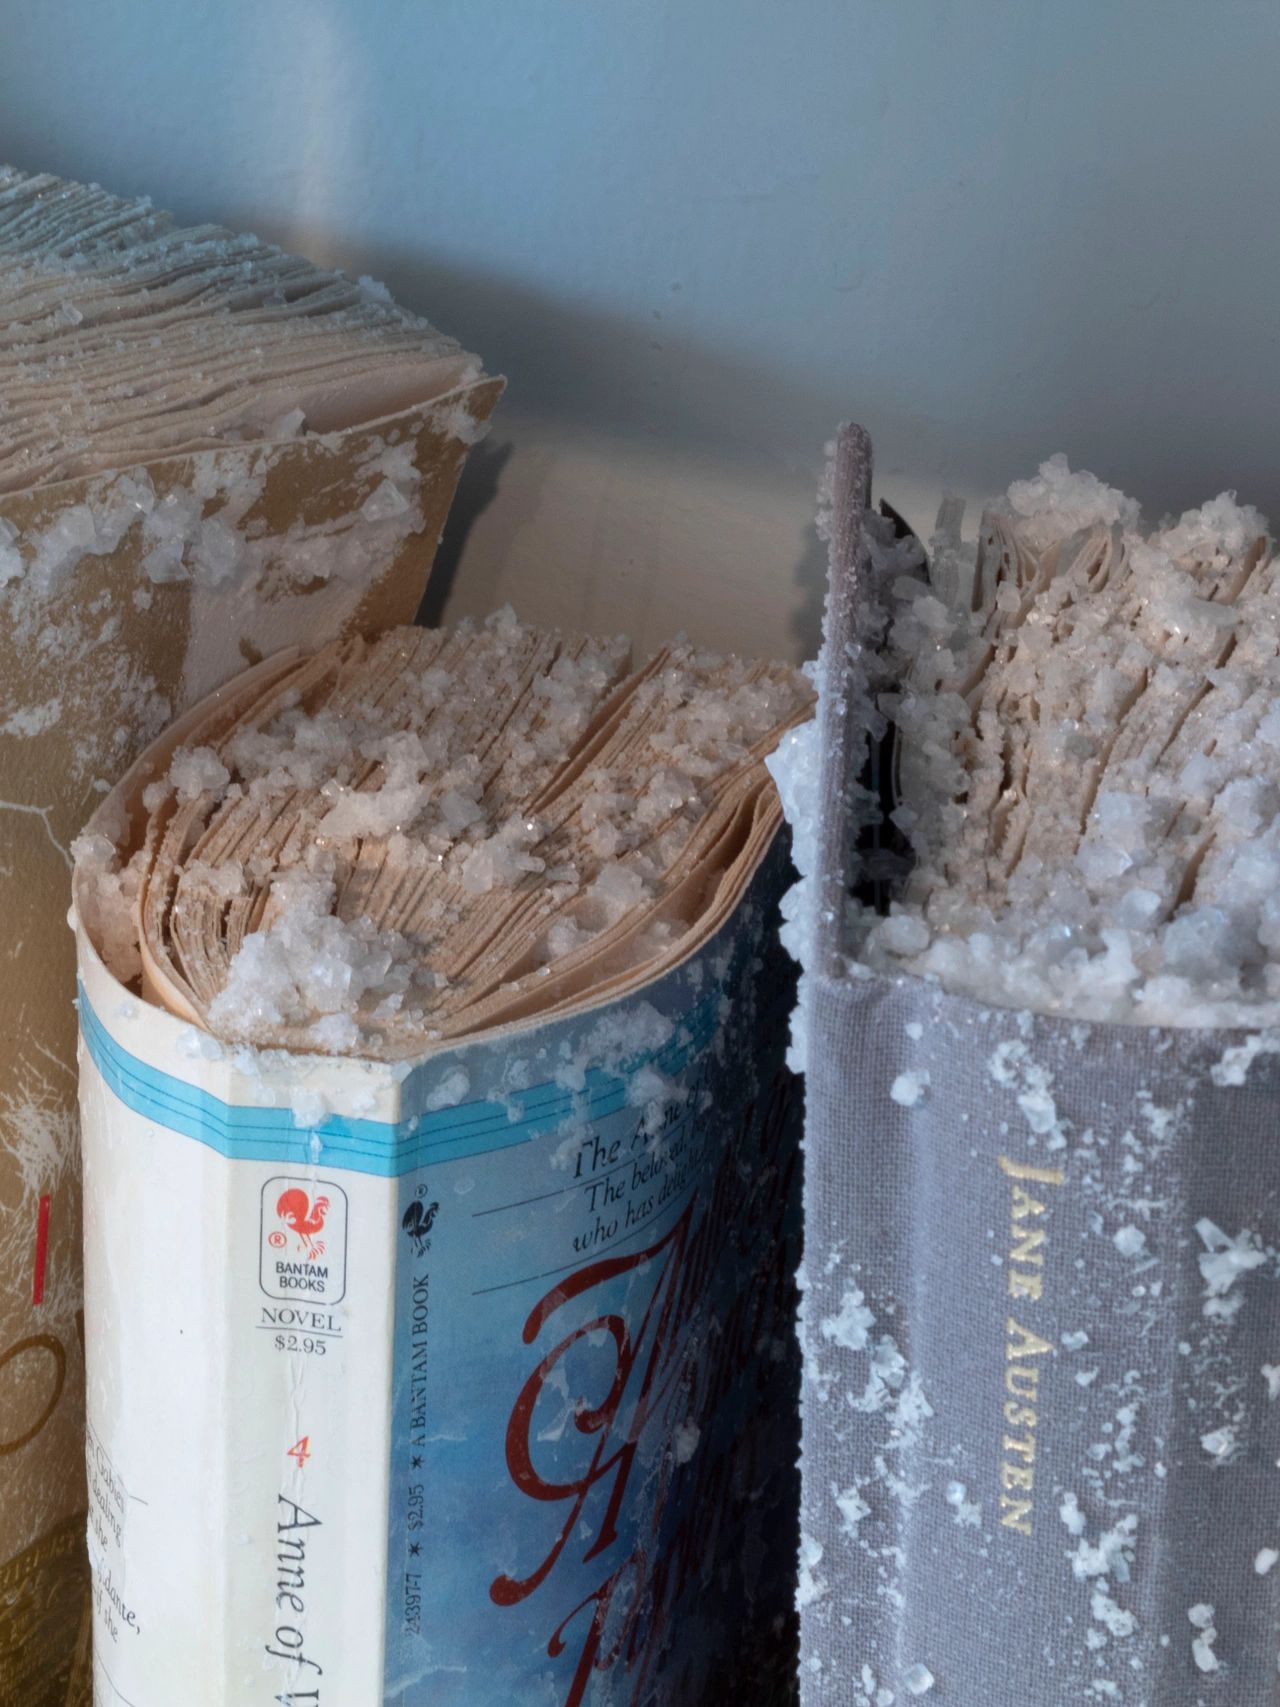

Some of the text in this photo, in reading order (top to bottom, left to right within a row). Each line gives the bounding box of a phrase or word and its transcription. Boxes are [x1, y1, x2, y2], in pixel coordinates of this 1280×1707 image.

[584, 1176, 625, 1212] The
[573, 1216, 618, 1252] who
[625, 1200, 654, 1228] has
[275, 1261, 328, 1279] BANTAM
[279, 1276, 325, 1293] BOOKS
[261, 1307, 342, 1332] NOVEL
[412, 1273, 429, 1336] BOOK
[274, 1334, 327, 1356] $2.95
[997, 1154, 1064, 1536] JANE AUSTEN
[410, 1340, 427, 1430] BANTAM
[287, 1435, 311, 1468] 4
[410, 1433, 427, 1448] A
[407, 1483, 426, 1532] $2.95
[276, 1493, 323, 1613] Anne
[265, 1625, 323, 1676] of
